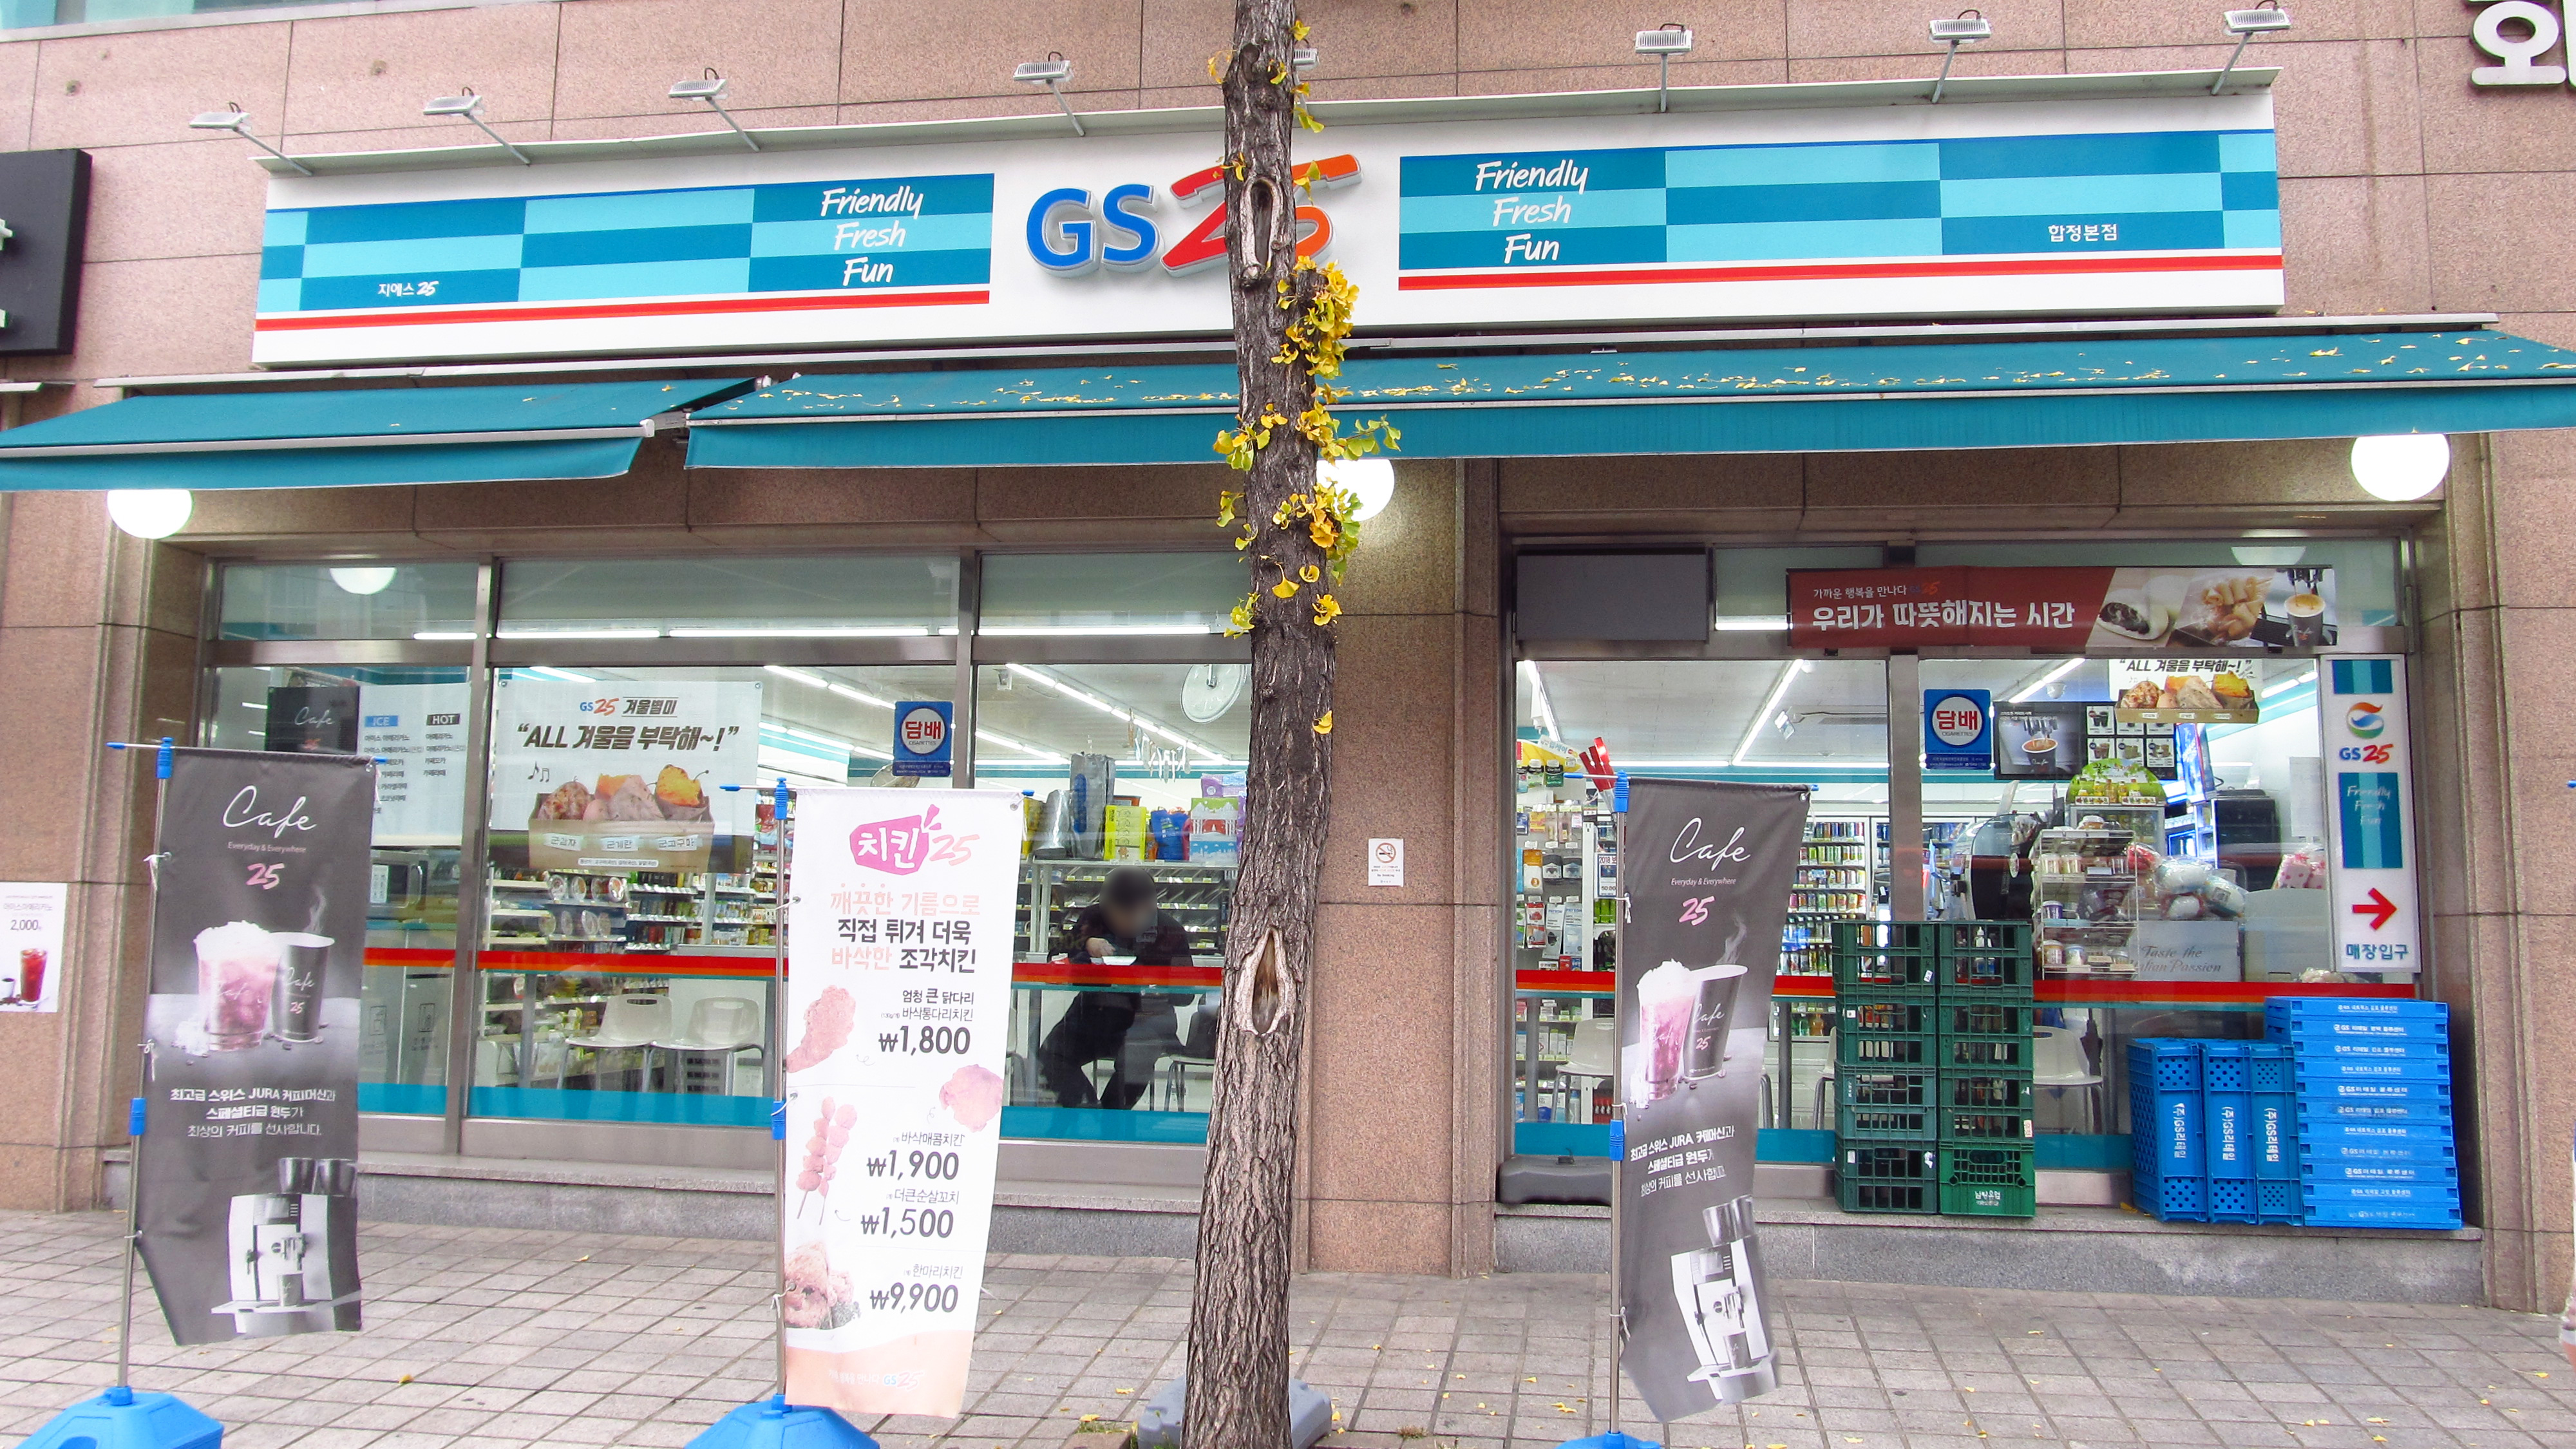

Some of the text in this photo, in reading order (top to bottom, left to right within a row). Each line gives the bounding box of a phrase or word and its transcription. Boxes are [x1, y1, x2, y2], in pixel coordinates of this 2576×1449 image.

[1476, 159, 1588, 194] Friendly
[820, 185, 924, 218] Friendly
[1493, 195, 1572, 227] Fresh
[835, 219, 906, 251] Fresh
[2048, 223, 2119, 243] 합정본점
[1504, 234, 1560, 264] Fun
[842, 256, 894, 285] Fun
[1814, 588, 1842, 600] 가까운
[1845, 587, 1873, 598] 행복을
[1877, 585, 1907, 597] 만나다
[1813, 600, 2075, 630] 우리가 따뜻해지는 시간
[2154, 659, 2190, 672] 겨울을
[580, 698, 677, 715] GS25 겨울별미
[294, 706, 335, 728] Cafe
[373, 717, 390, 726] ICE
[431, 715, 455, 724] HOT
[1936, 711, 1978, 730] 담배
[573, 725, 636, 750] 겨울을
[905, 721, 942, 739] 담배
[2339, 744, 2394, 764] GS25
[2347, 785, 2391, 802] Friendly
[223, 785, 317, 838] Cafe
[2354, 799, 2385, 811] Fresh
[2360, 814, 2382, 825] Fun
[228, 842, 260, 852] Everyday
[267, 844, 307, 854] Everywhere
[1669, 817, 1750, 871] Cafe
[245, 862, 285, 890] 25
[1671, 877, 1696, 887] Everyday
[1703, 877, 1736, 886] Everywhere
[830, 891, 980, 916] 깨끗한 기름으로
[1678, 895, 1715, 926] 25
[838, 918, 971, 945] 직접 튀겨 더욱
[831, 946, 976, 973] 바삭한 조각치킨
[2183, 945, 2202, 958] the
[2346, 943, 2409, 961] 매장입구
[2170, 960, 2222, 973] Passion
[902, 988, 974, 1005] 엄청 큰 닭다리
[290, 1001, 305, 1015] 25
[902, 1007, 974, 1021] 바삭통다리치킨
[878, 1025, 971, 1056] ₩1,800
[1695, 1036, 1711, 1050] 25
[170, 1088, 336, 1102] 최고급 스위스 JURA 커피머신과
[205, 1104, 304, 1120] 스페셜티급 원두가
[187, 1124, 223, 1137] 최상의
[227, 1122, 263, 1137] 커피를
[2173, 1103, 2186, 1158] (주)GS리테일
[2221, 1106, 2236, 1160] (주)GS리테일
[2264, 1108, 2279, 1162] (주)GS리테일
[1630, 1144, 1648, 1162] 최고급
[1649, 1139, 1668, 1155] 스위스
[1669, 1133, 1694, 1149] JURA
[866, 1150, 960, 1180] ₩1,900
[1647, 1153, 1684, 1175] 스페셜티급
[1658, 1173, 1683, 1189] 커피를
[860, 1207, 954, 1238] ₩1,500
[913, 1264, 963, 1279] 한마리치킨
[869, 1282, 959, 1314] ₩9,900
